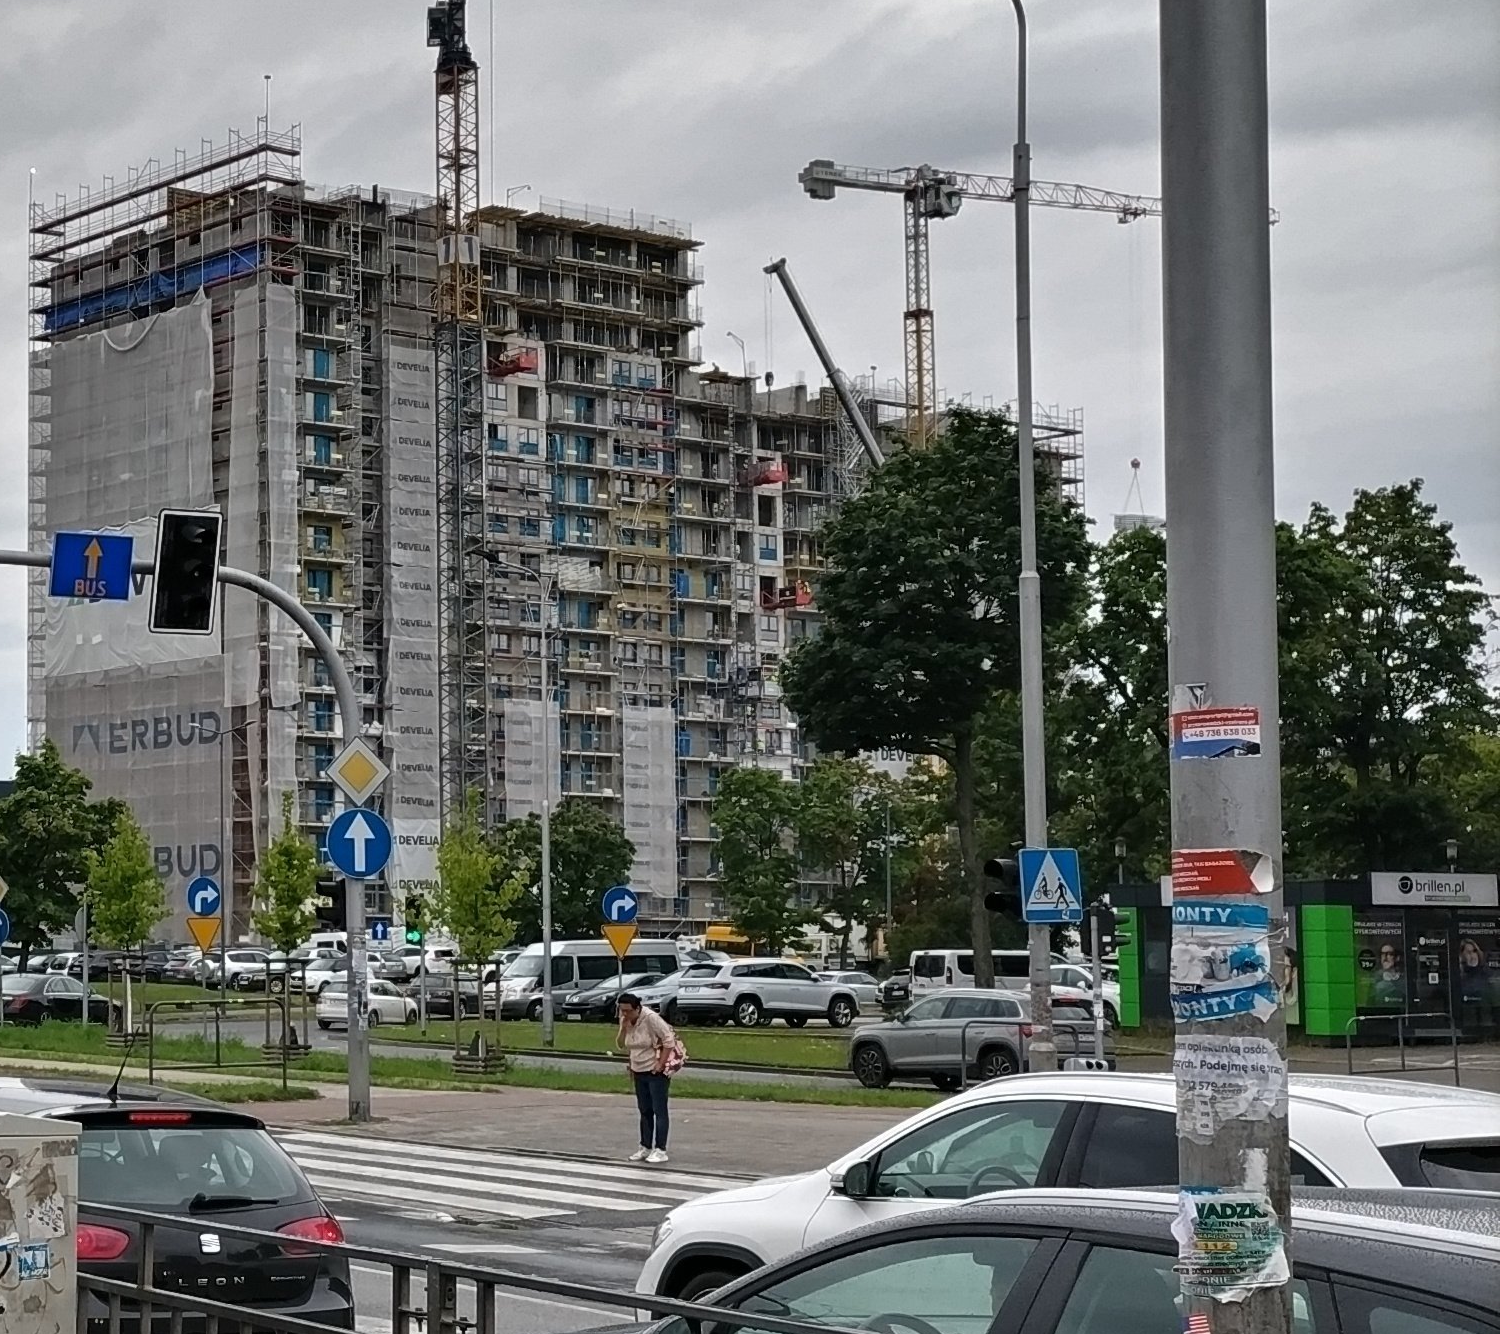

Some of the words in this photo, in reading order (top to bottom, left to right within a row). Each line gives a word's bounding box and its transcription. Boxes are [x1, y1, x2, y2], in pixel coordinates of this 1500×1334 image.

[397, 362, 430, 373] DEVELIA
[397, 398, 430, 410] DEVELIA
[398, 437, 431, 448] DEVELIA
[398, 474, 431, 484] DEVELIA
[399, 507, 431, 517] DEVELIA
[397, 542, 430, 553] DEVELIA
[74, 579, 106, 597] BUS
[399, 581, 431, 592] DEVELIA
[400, 618, 432, 628] DEVELIA
[400, 651, 432, 662] DEVELIA
[400, 687, 434, 697] DEVELIA
[109, 711, 221, 754] ERBUD
[400, 726, 434, 736] DEVELIA
[881, 748, 913, 763] DEVE
[401, 763, 434, 773] DEVELIA
[401, 796, 434, 807] DEVELIA
[399, 835, 439, 846] DEVELIA
[153, 844, 221, 878] BUD
[1415, 879, 1465, 895] brillen.pl
[1200, 1059, 1248, 1074] Podejmę
[1250, 1062, 1265, 1074] się
[179, 1276, 245, 1287] LEON
